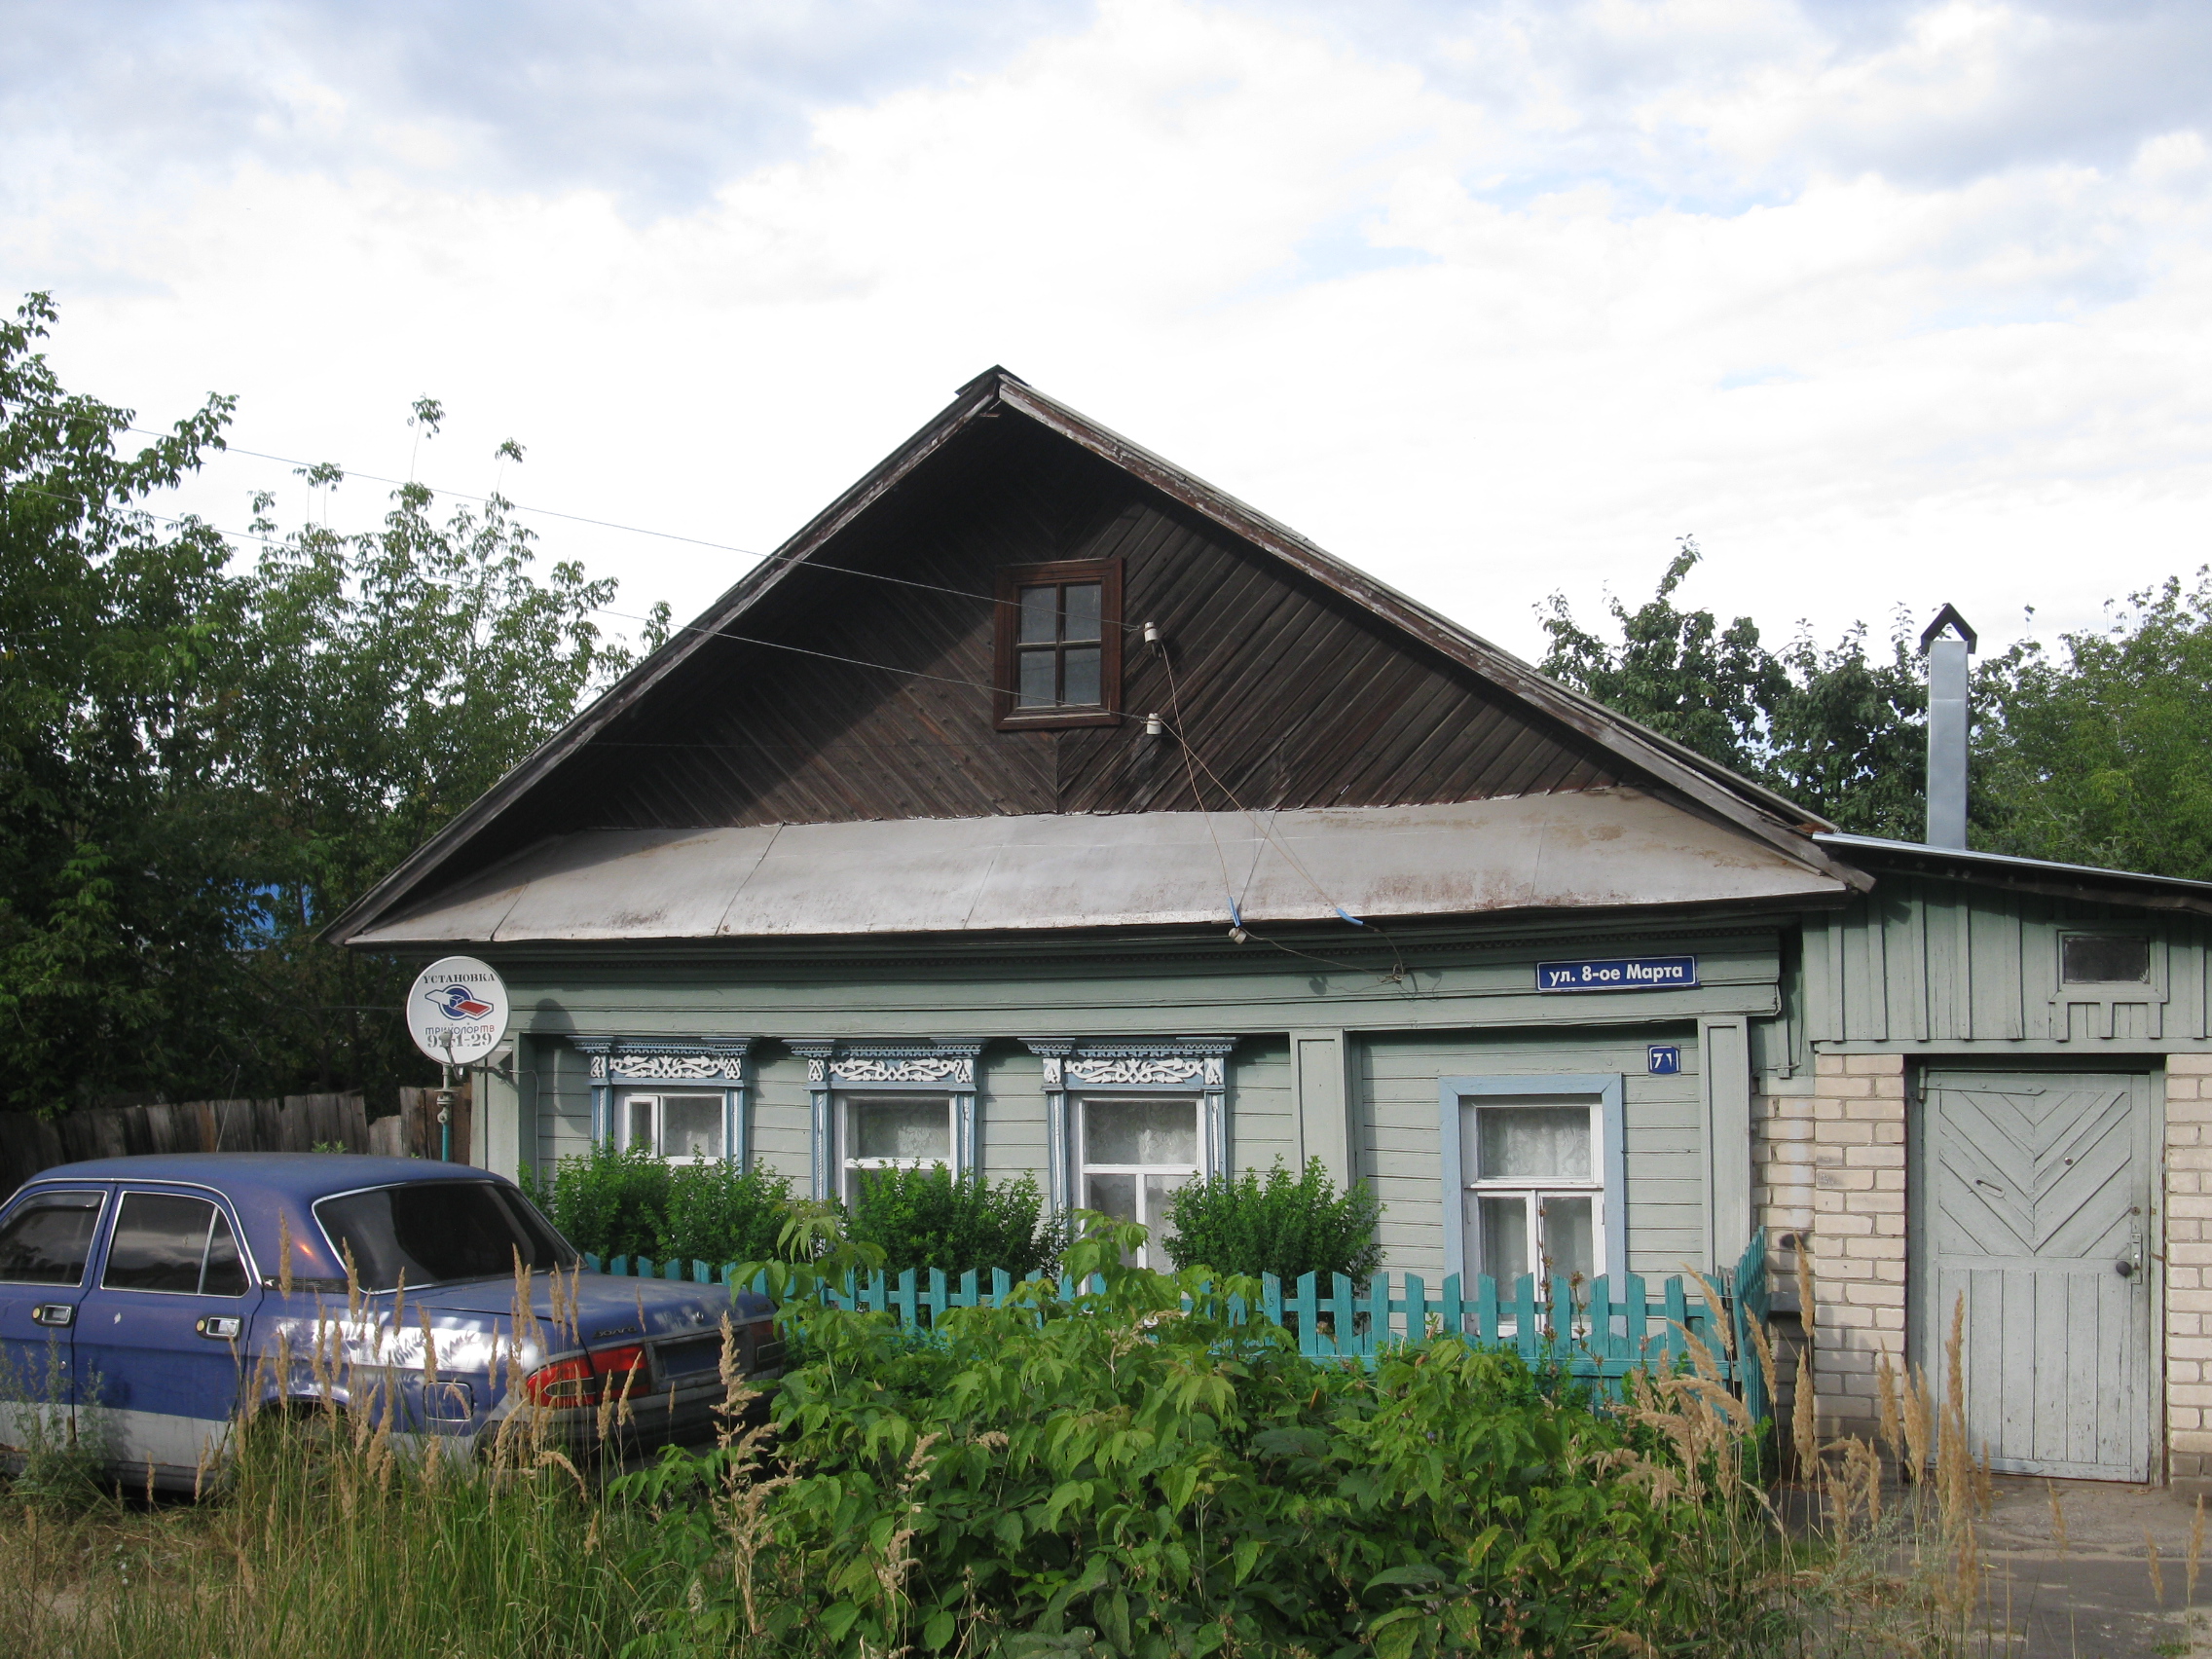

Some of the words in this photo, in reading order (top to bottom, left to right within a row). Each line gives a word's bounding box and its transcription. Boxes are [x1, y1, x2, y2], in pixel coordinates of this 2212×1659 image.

[423, 973, 496, 984] УСТАНОВКА
[1548, 970, 1576, 986] ул.
[1581, 965, 1621, 981] 8-ое
[1626, 963, 1683, 982] Марта
[1652, 1052, 1673, 1069] 71
